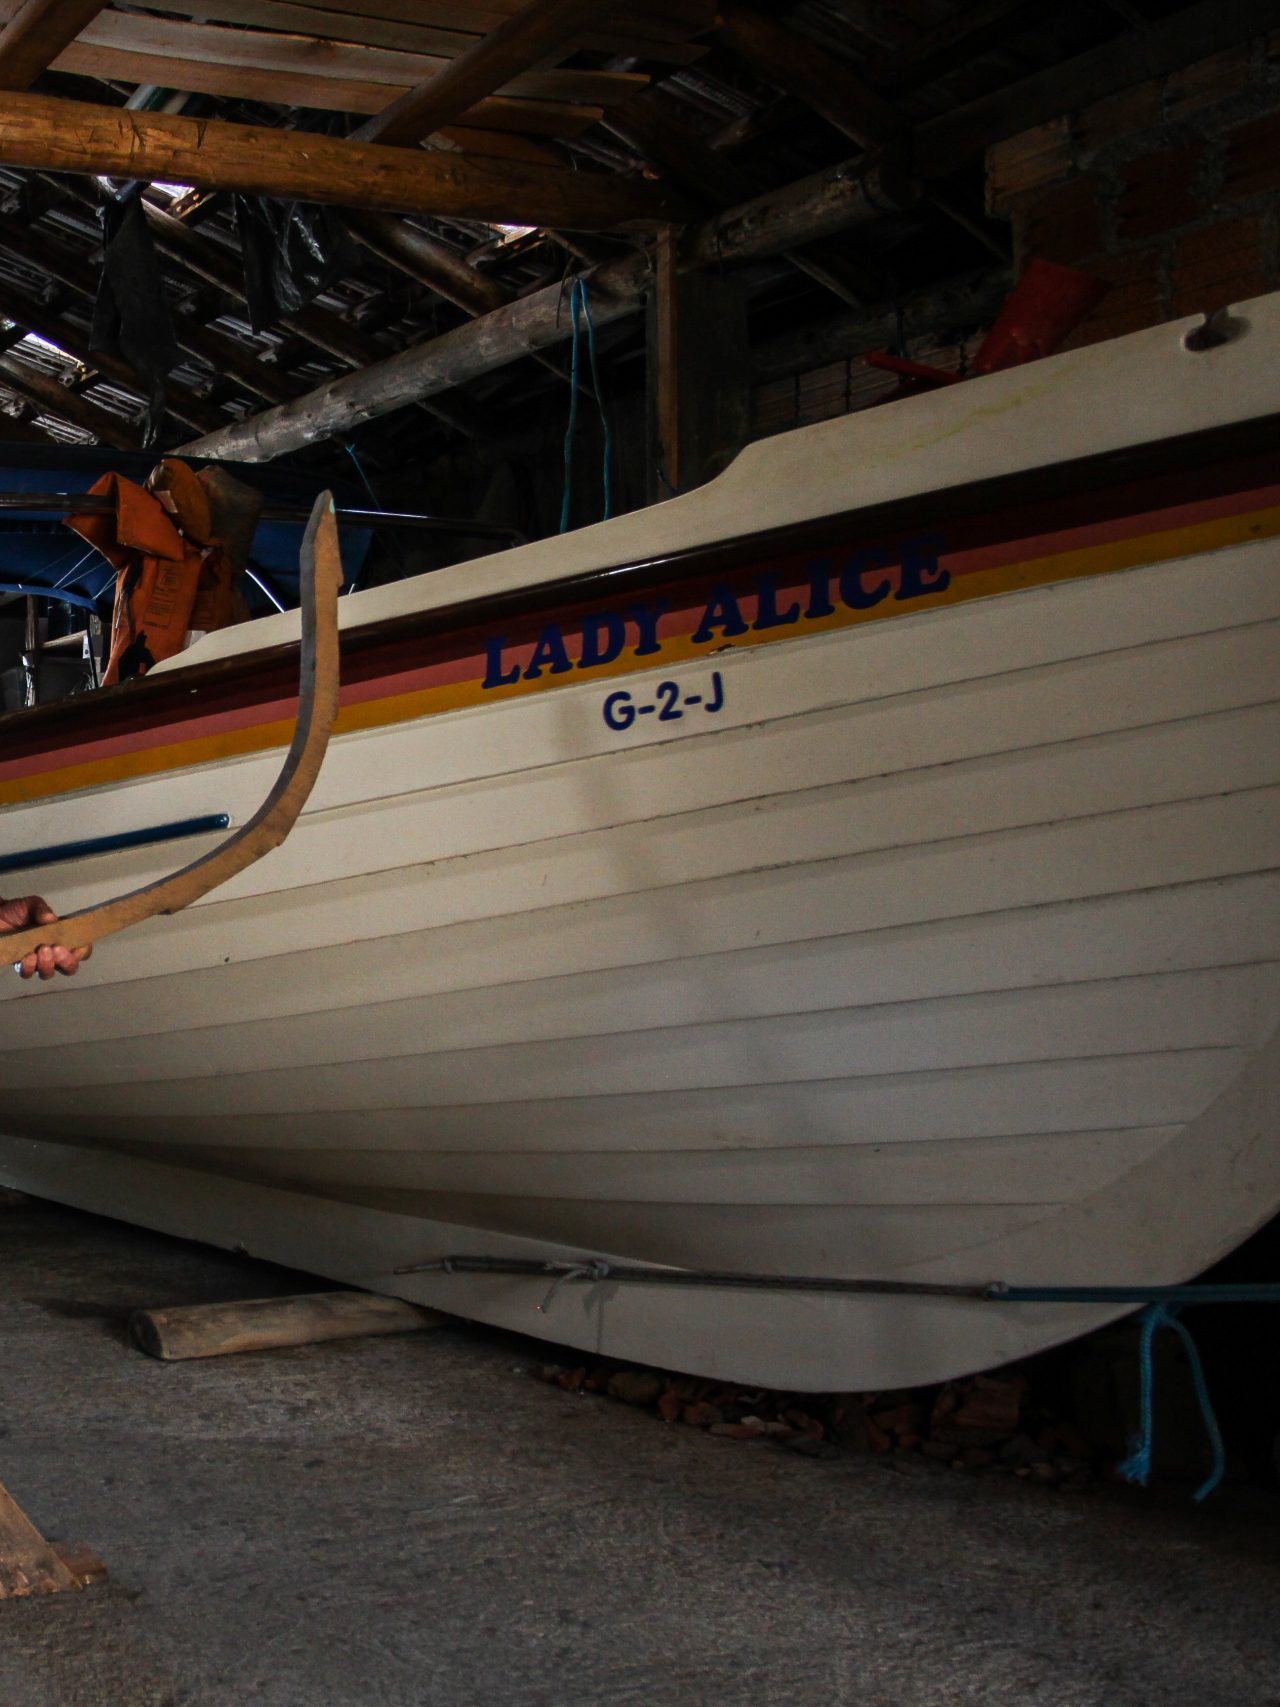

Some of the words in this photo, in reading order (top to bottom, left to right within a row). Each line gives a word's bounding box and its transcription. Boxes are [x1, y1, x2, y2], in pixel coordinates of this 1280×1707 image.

[482, 597, 669, 689] LADY
[693, 535, 951, 643] ALICE
[603, 671, 725, 731] G-2-J
